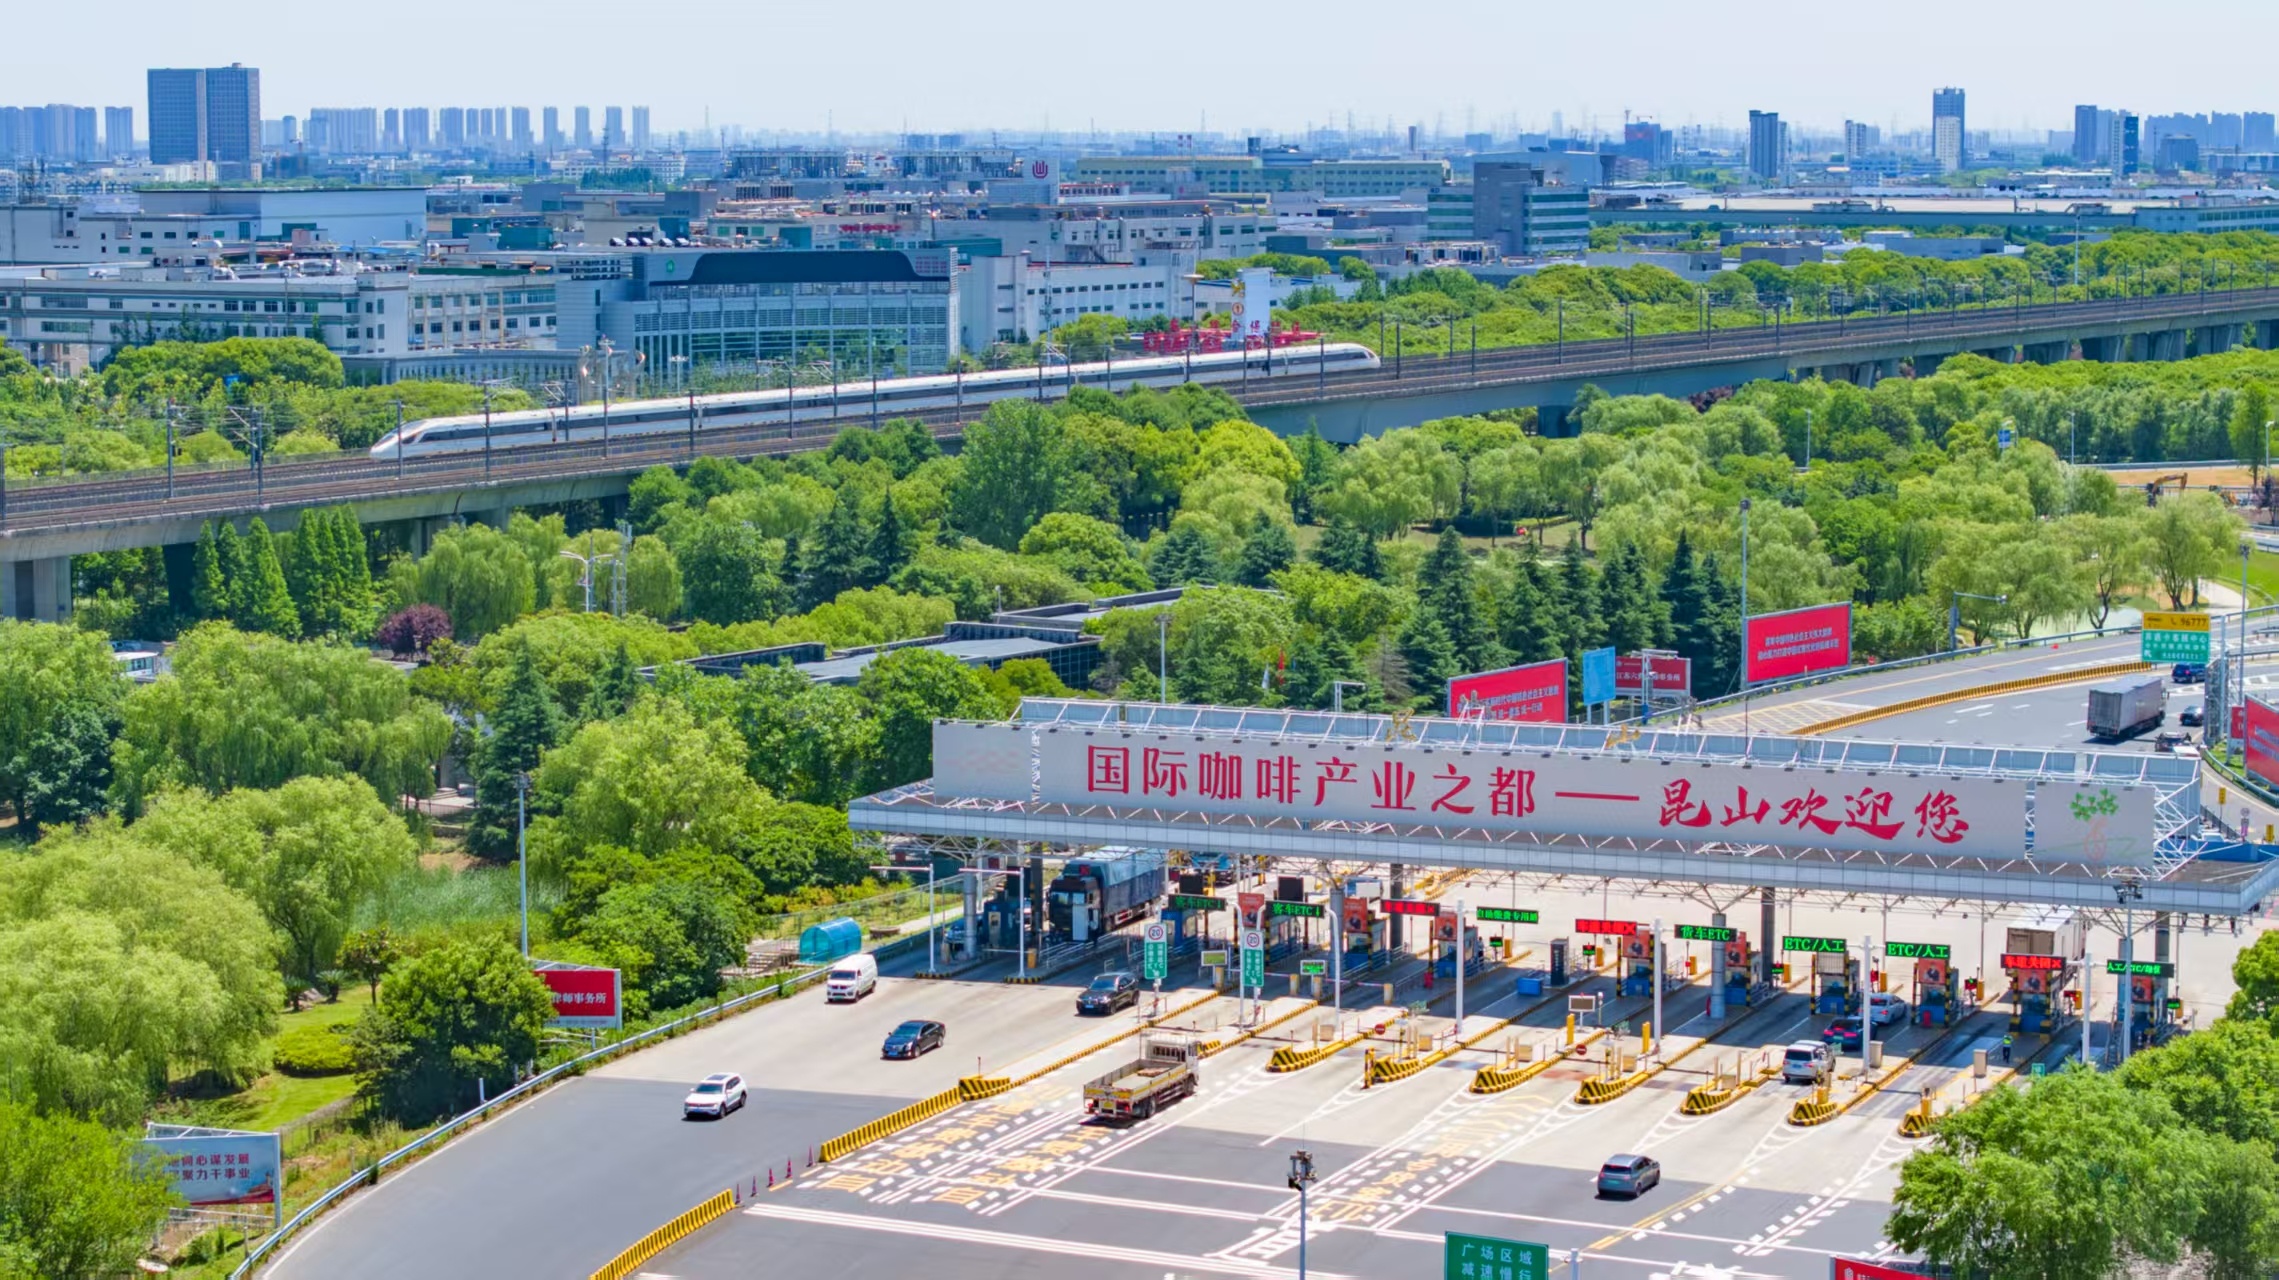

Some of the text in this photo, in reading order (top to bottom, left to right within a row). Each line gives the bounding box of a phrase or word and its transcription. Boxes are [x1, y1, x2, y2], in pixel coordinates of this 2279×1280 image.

[1272, 902, 1313, 915] 客车ETC
[1681, 925, 1730, 941] 货车ETC
[1784, 937, 1845, 952] ETC/人工
[1887, 943, 1949, 958] ETC/人工
[1461, 1243, 1533, 1266] 广场区域
[1461, 1262, 1533, 1280] 减速慢行
